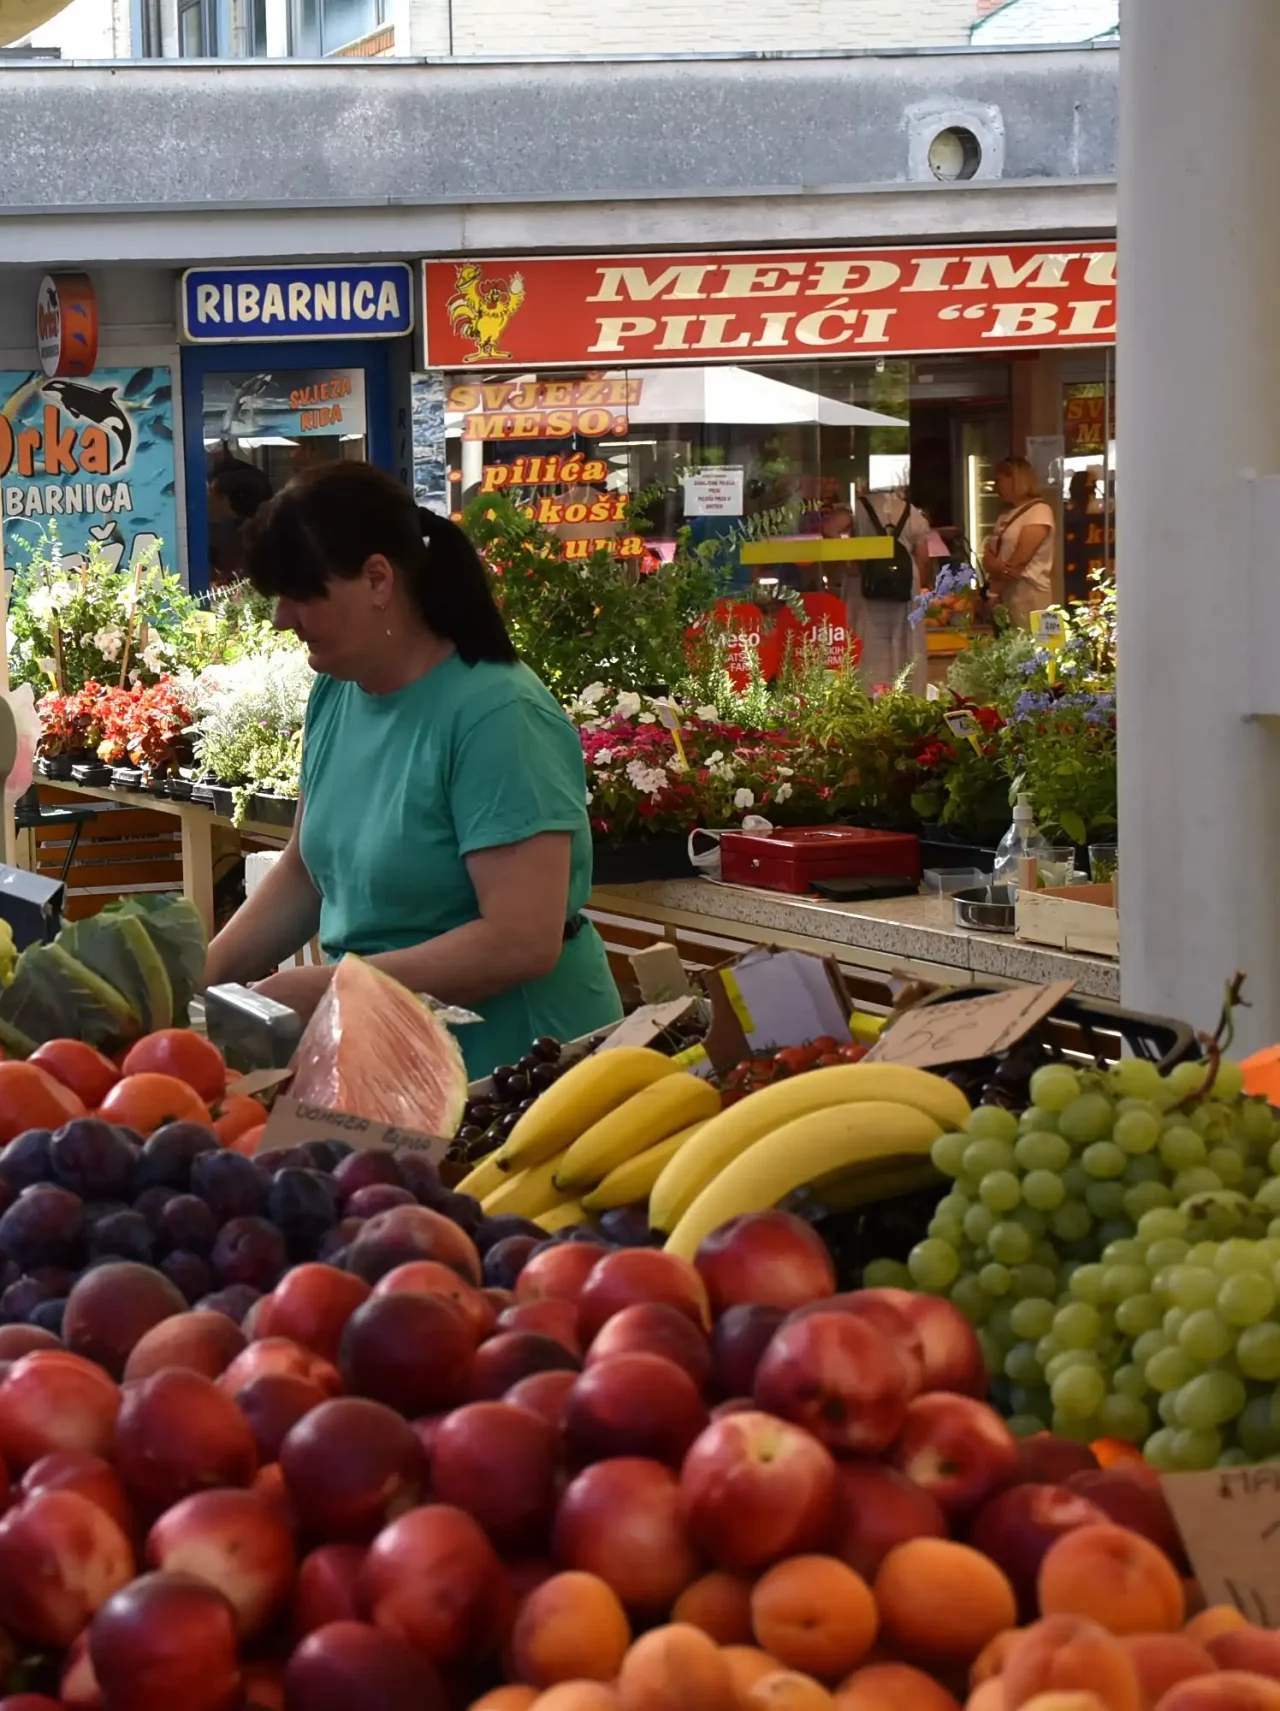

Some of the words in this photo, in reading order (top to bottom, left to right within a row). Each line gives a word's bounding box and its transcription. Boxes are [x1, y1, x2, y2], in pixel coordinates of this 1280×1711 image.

[196, 280, 401, 324] RIBARNICA
[587, 297, 897, 353] PILIĆI
[447, 371, 641, 412] SVJEŽE
[299, 403, 343, 433] RIBA
[463, 409, 628, 441] MESO:
[481, 452, 608, 493] pilića
[1, 482, 133, 519] BARNICA
